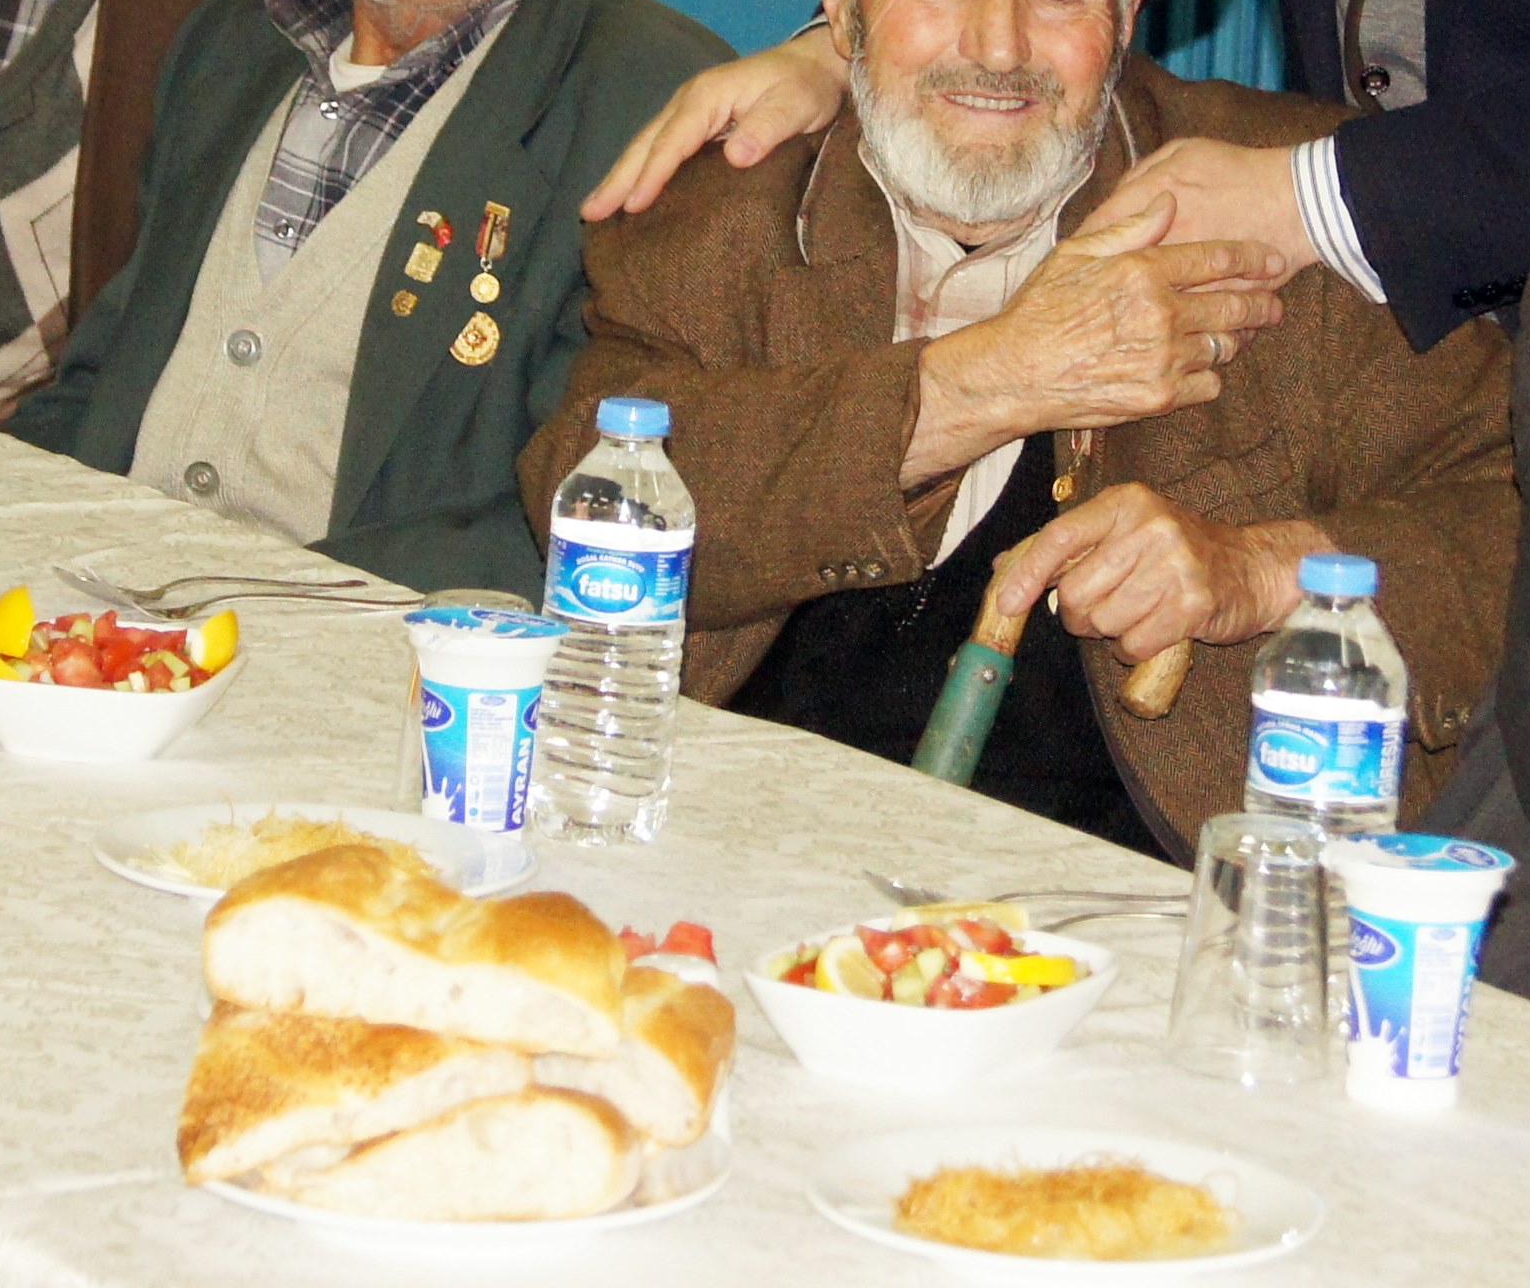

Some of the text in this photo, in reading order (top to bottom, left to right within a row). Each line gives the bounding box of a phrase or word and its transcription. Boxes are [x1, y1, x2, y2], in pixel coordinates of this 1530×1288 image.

[578, 573, 639, 602] fatsu
[1259, 740, 1317, 774] fatsu
[511, 737, 532, 825] AYRAN
